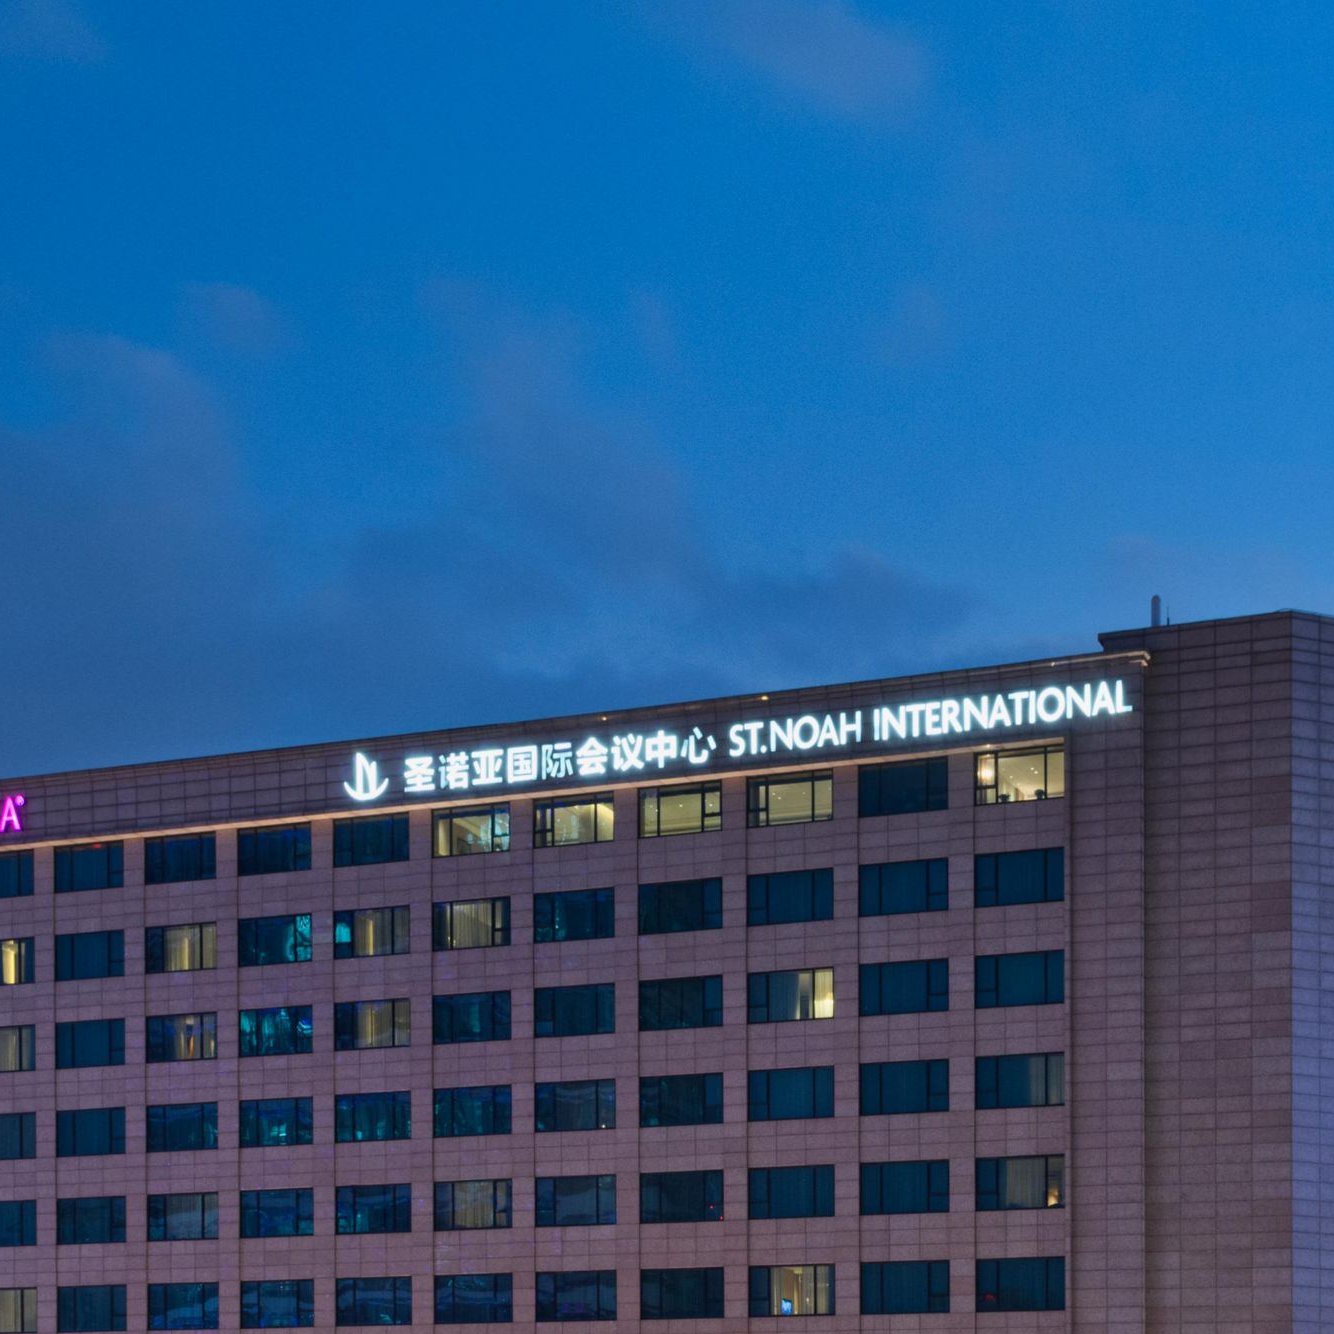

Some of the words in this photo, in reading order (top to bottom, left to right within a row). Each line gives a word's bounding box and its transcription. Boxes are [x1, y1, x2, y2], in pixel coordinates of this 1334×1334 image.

[403, 726, 717, 794] 圣诺亚国际会议中心
[873, 679, 1133, 742] INTERNATIONAL
